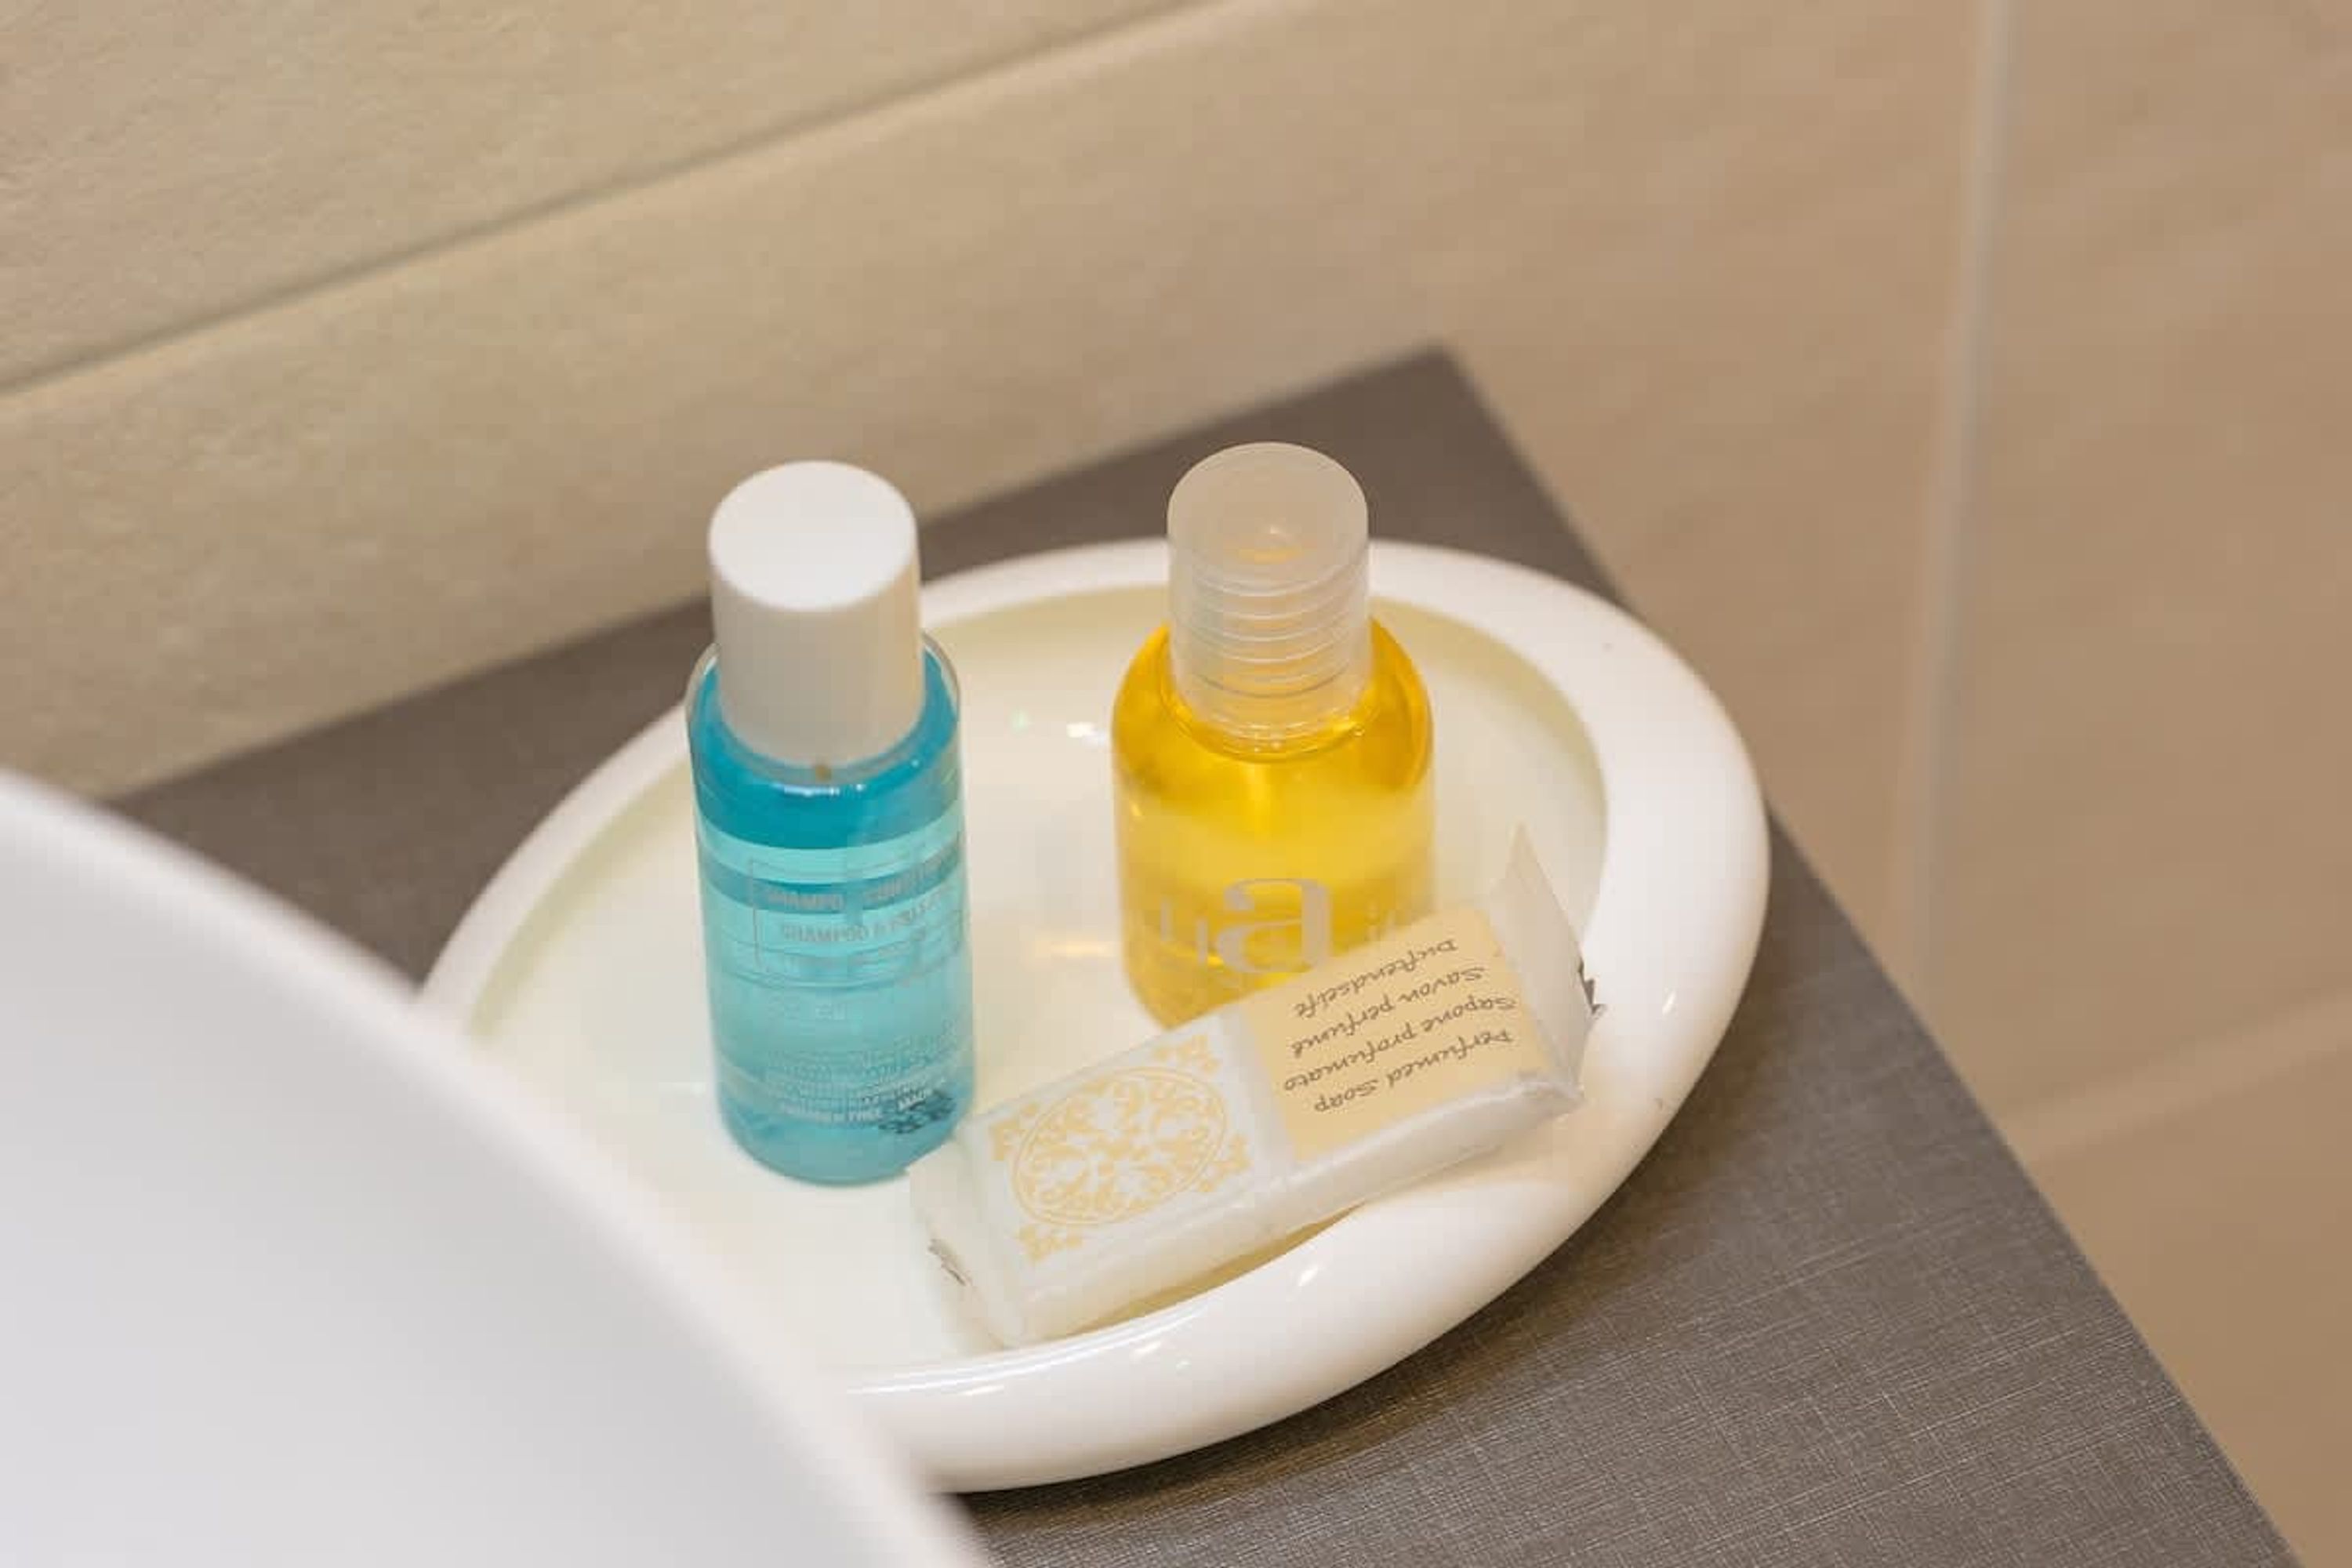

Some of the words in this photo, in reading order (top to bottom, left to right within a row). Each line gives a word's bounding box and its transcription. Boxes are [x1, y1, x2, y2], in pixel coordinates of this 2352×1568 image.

[1398, 966, 1486, 1003] Savon
[1421, 993, 1517, 1033] Sapone
[1283, 1022, 1417, 1092] profumato
[1386, 1028, 1514, 1088] Perfumed
